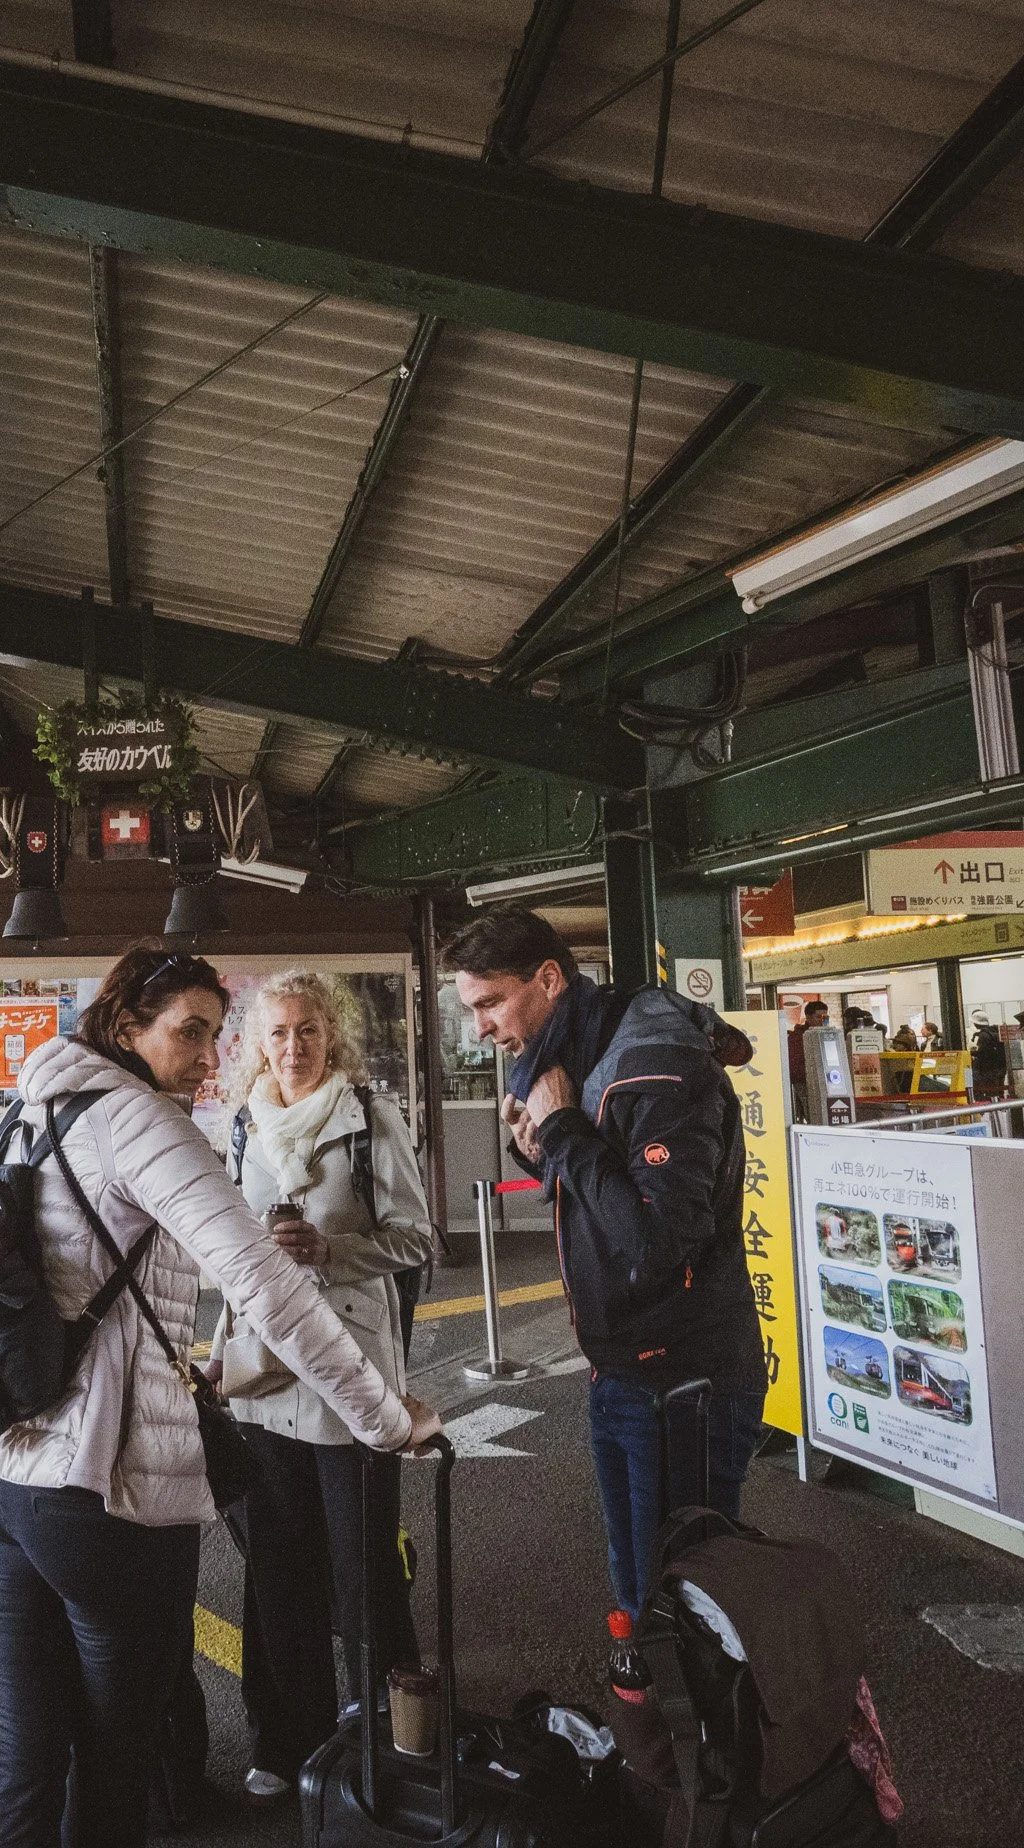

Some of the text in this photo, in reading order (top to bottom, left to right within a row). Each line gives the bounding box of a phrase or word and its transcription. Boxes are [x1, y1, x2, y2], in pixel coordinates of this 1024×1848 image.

[77, 745, 172, 772] 友好のカウベル
[960, 861, 1005, 884] 出口
[830, 1160, 935, 1186] 小田急グループは、
